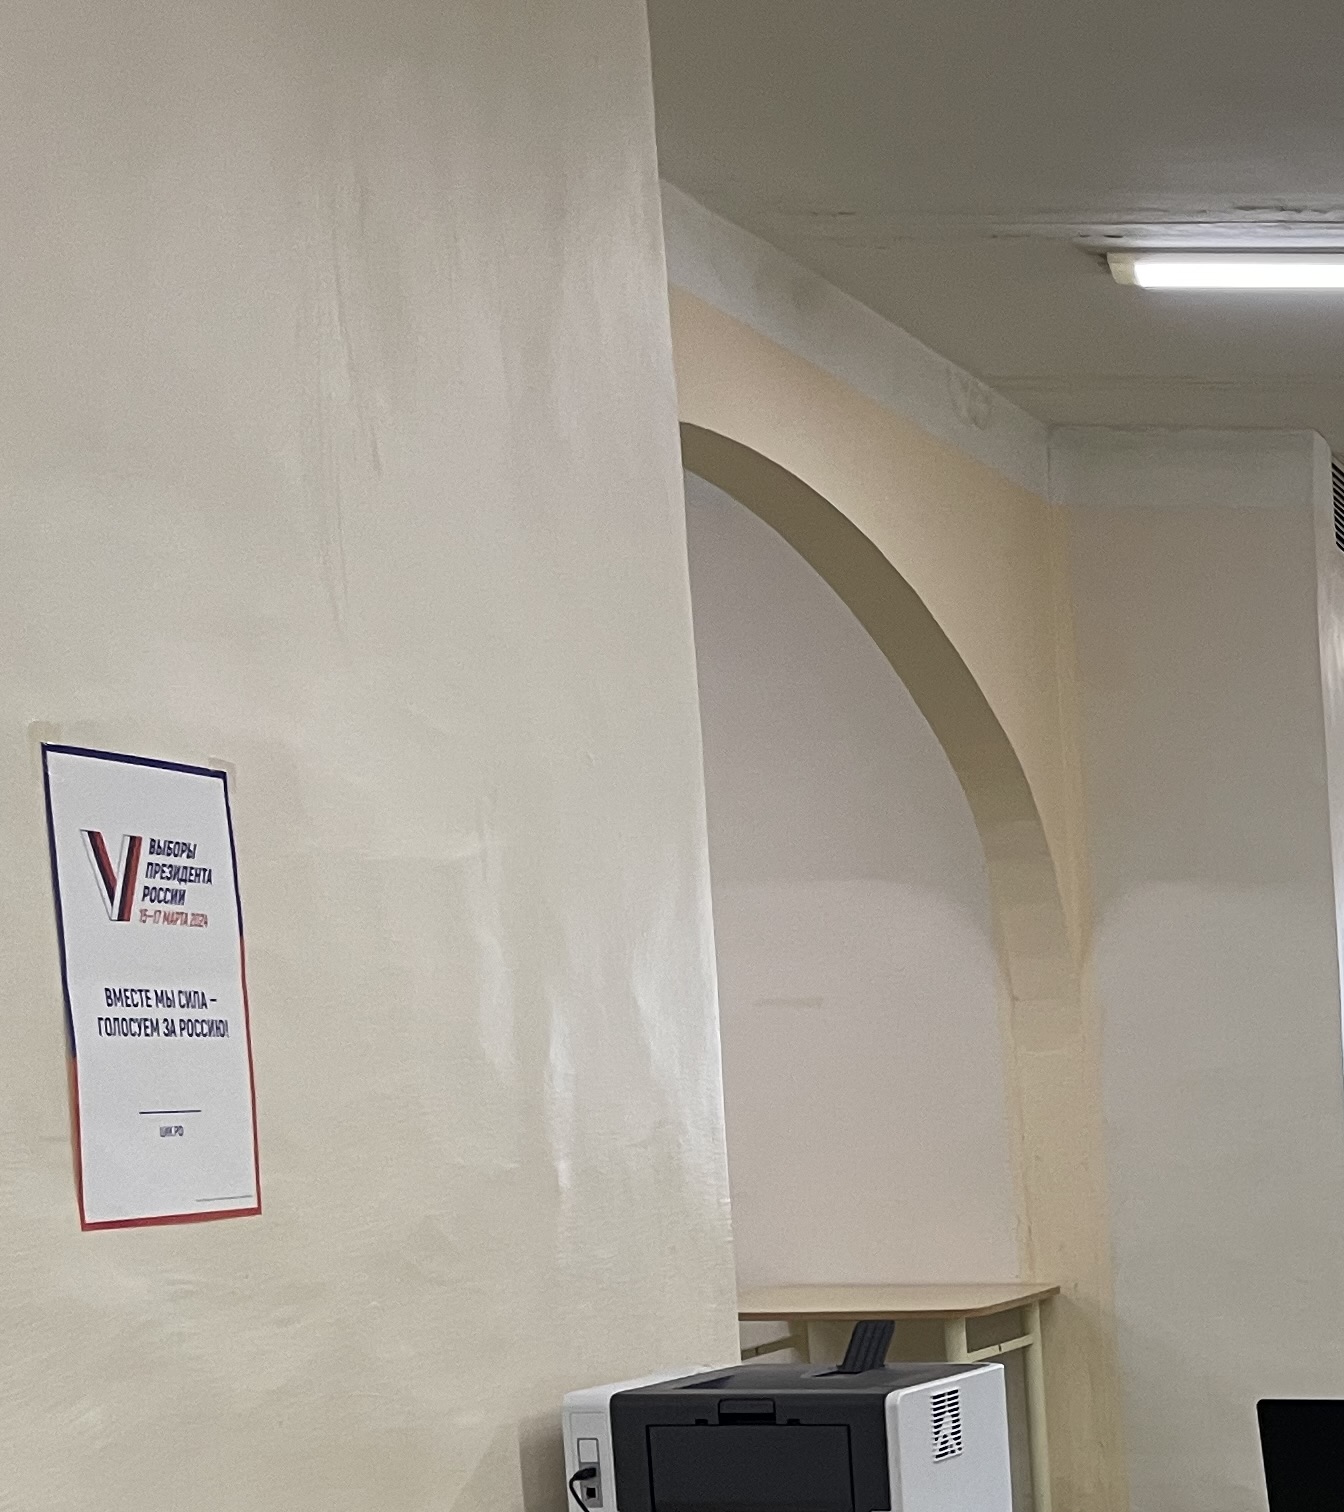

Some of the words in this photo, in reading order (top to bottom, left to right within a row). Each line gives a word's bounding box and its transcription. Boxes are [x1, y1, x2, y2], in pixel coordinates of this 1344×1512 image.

[149, 838, 197, 859] ВЫБОРЫ
[145, 862, 212, 885] ПРЕЗИДЕНТА
[141, 886, 186, 905] РОССИИ
[162, 910, 188, 926] МАРТА
[104, 987, 152, 1008] ВМЕСТЕ
[154, 989, 177, 1008] МЫ
[178, 990, 208, 1009] СИЛА
[97, 1017, 160, 1037] ГОЛОСУЕМ
[163, 1018, 177, 1037] ЗА
[179, 1019, 230, 1038] РОССИЮ!
